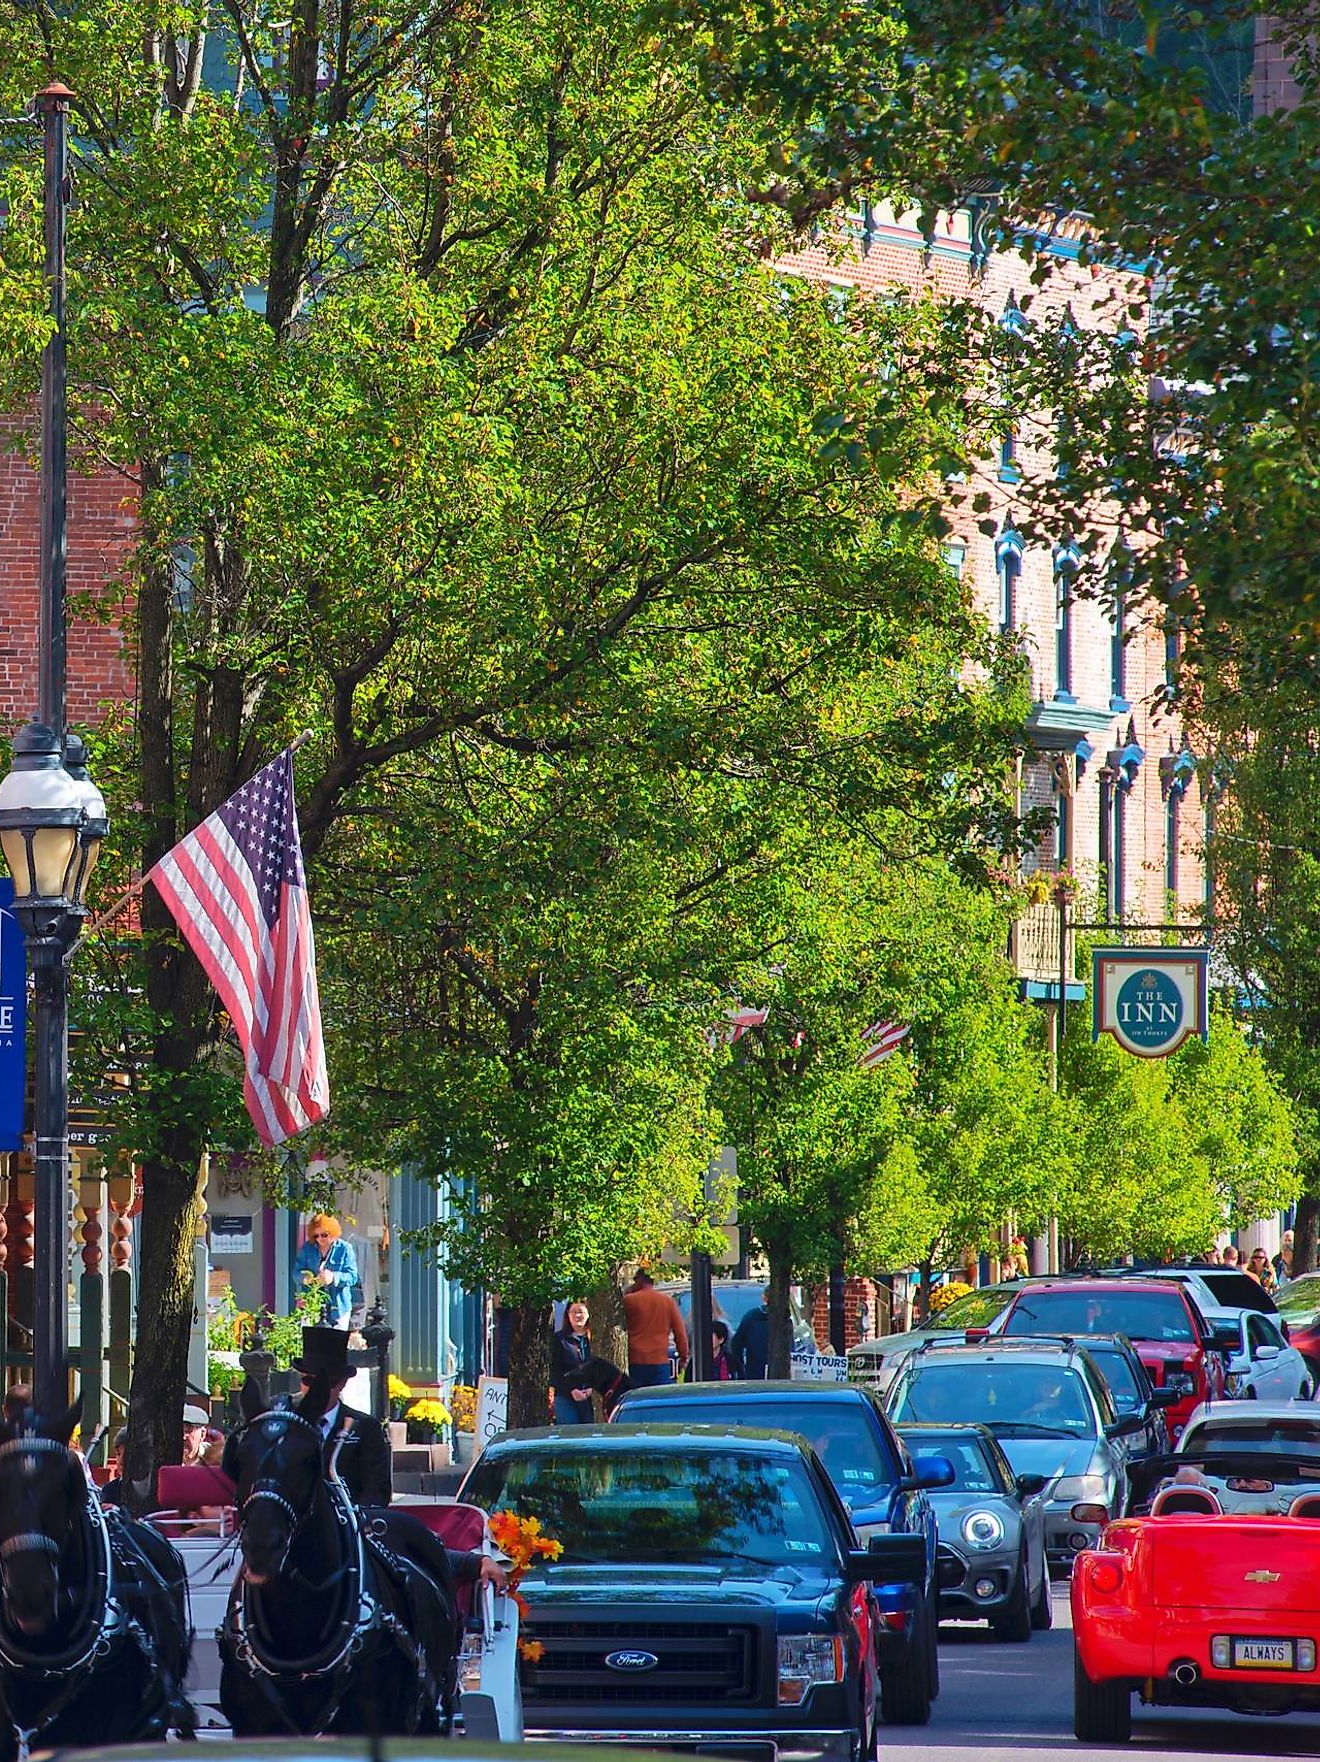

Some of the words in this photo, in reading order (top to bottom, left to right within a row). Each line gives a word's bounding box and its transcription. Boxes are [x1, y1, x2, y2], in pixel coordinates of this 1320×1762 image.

[1136, 991, 1163, 1001] THE
[1121, 1002, 1178, 1023] INN
[816, 1356, 848, 1368] TOURS
[1243, 1646, 1284, 1660] ALWAYS
